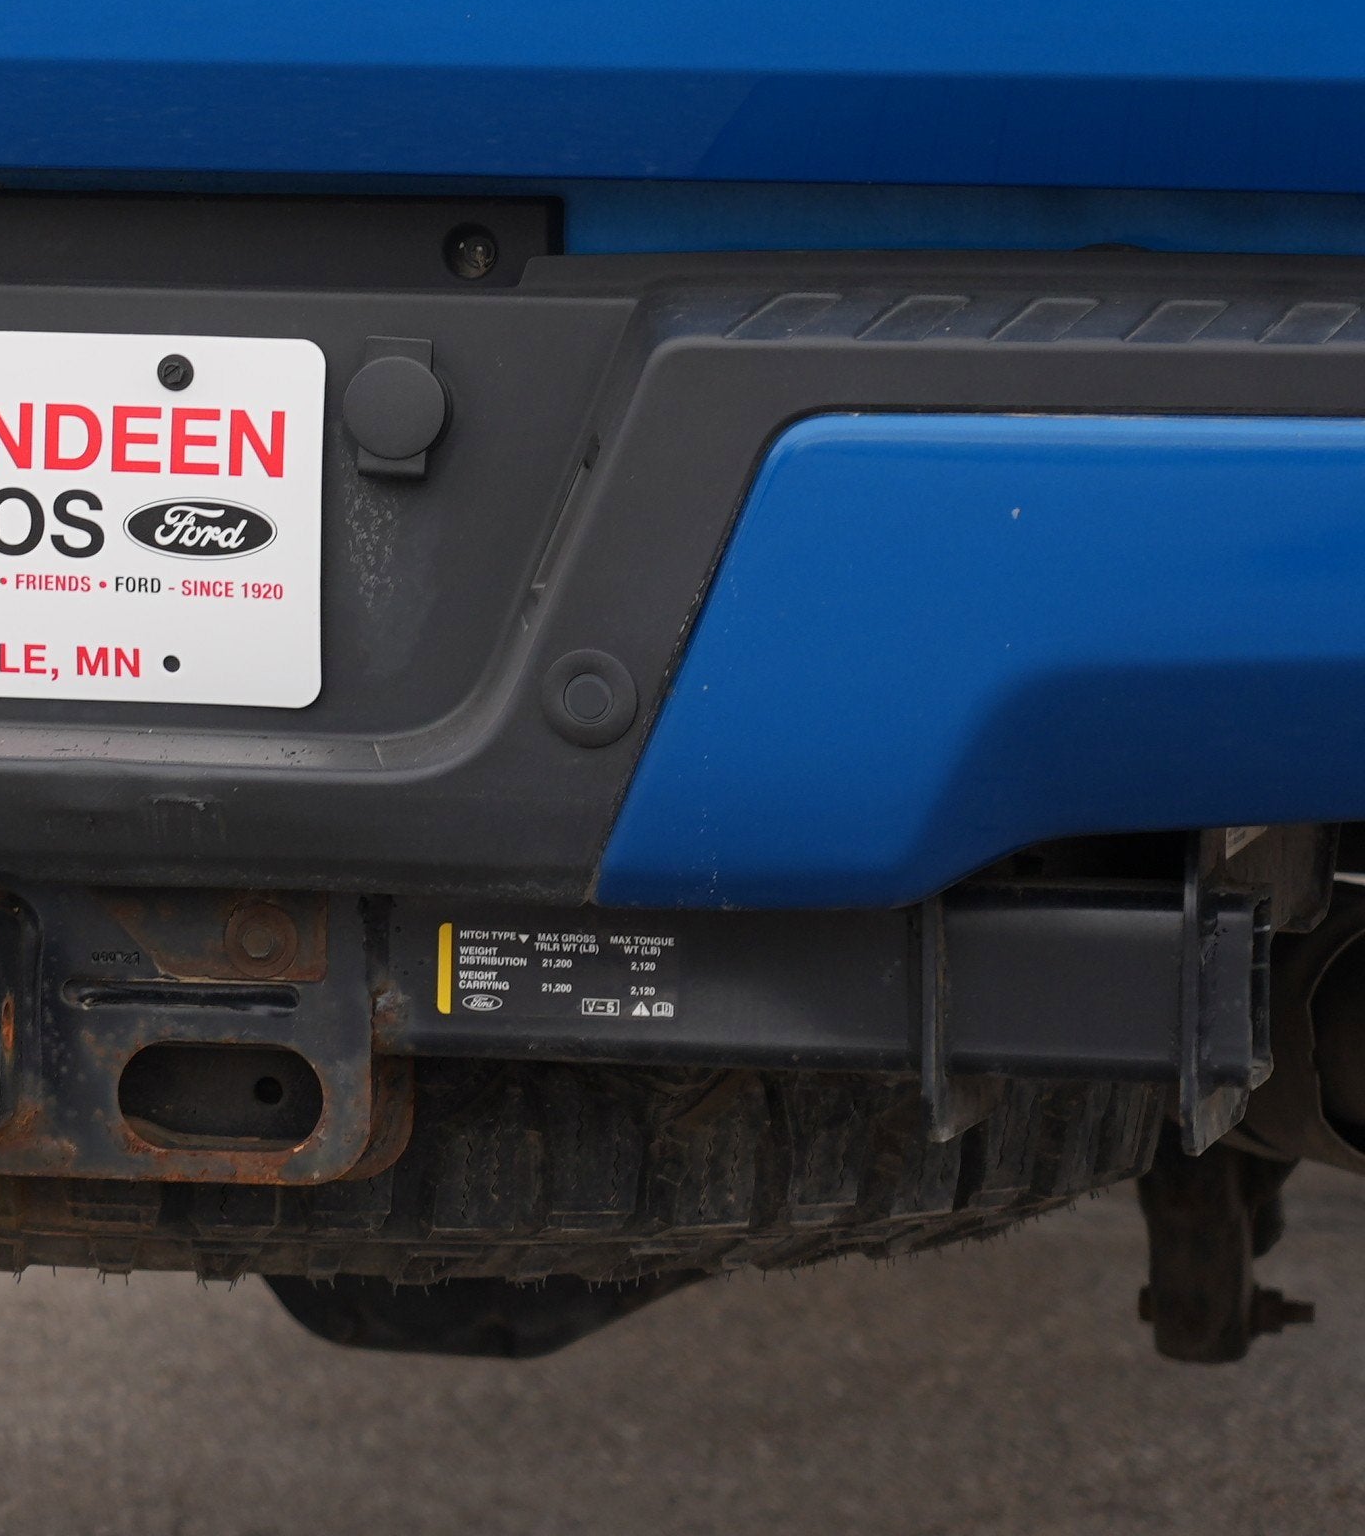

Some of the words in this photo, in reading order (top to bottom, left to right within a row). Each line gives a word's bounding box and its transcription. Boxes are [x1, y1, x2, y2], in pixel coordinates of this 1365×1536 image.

[155, 506, 245, 549] Ford
[15, 573, 91, 593] FRIENDS
[113, 576, 161, 594] FORD
[181, 579, 236, 597] SINCE
[241, 581, 285, 599] 1920
[76, 646, 141, 677] MN
[459, 930, 489, 940] HITCH
[491, 931, 517, 940] TYPE
[537, 933, 559, 942] MAX
[561, 934, 596, 944] GROSS
[610, 936, 631, 944] MAX
[634, 936, 675, 946] TONGUE
[459, 946, 498, 955] WEIGHT
[534, 942, 560, 952] TRLR
[562, 943, 577, 953] WT
[579, 944, 599, 955] (LB)
[624, 945, 639, 954] WT
[641, 946, 660, 957] (LB)
[459, 955, 527, 966] DISTRIBUTION
[542, 958, 573, 969] 21,200
[630, 962, 656, 972] 2,120
[459, 970, 498, 980] WEIGHT
[459, 980, 509, 990] CARRYING
[541, 983, 572, 994] 21,200
[630, 986, 655, 996] 2,120
